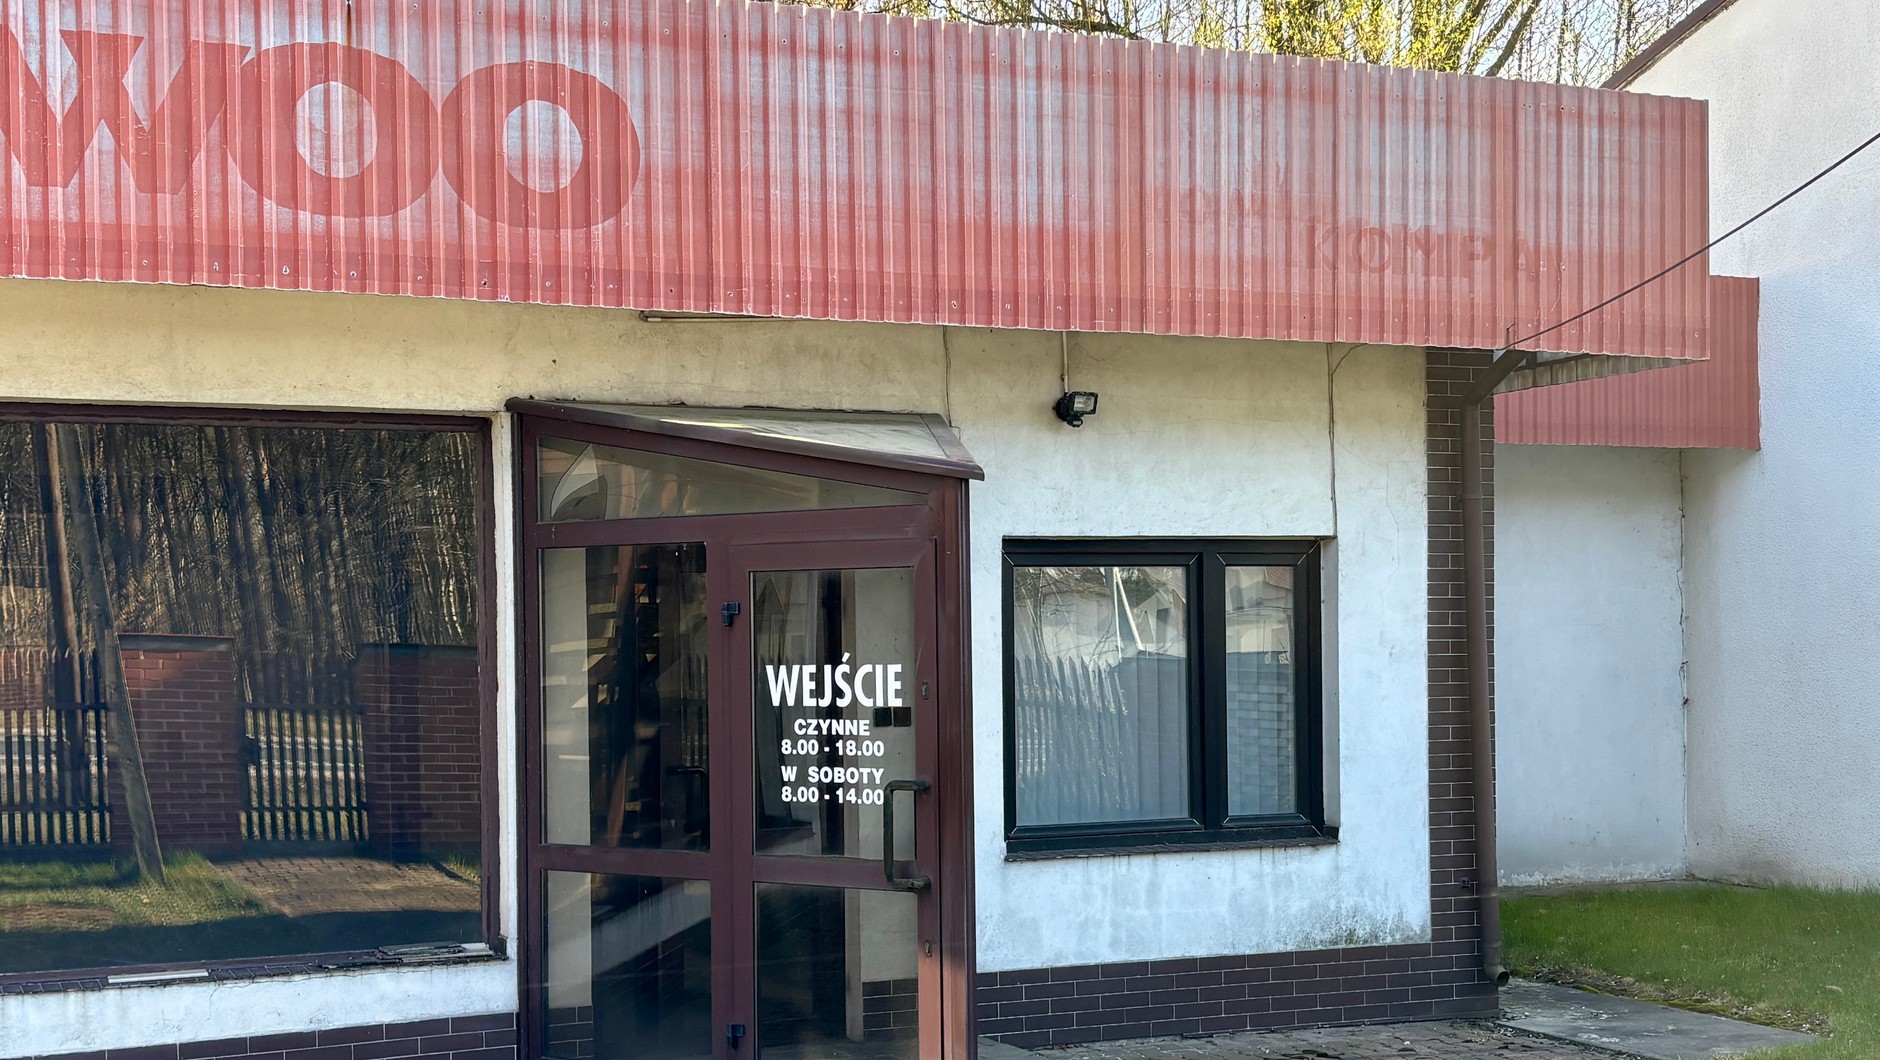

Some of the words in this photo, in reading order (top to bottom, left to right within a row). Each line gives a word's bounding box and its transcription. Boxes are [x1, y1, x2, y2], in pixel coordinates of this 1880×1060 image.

[765, 652, 903, 708] WEJŚCIE
[793, 719, 871, 736] CZYNNE
[781, 739, 819, 756] 8.00
[835, 739, 885, 757] 18.00
[781, 765, 798, 782] W
[807, 766, 885, 785] SOBOTY
[781, 786, 819, 803] 8.00
[835, 787, 885, 805] 14.00
